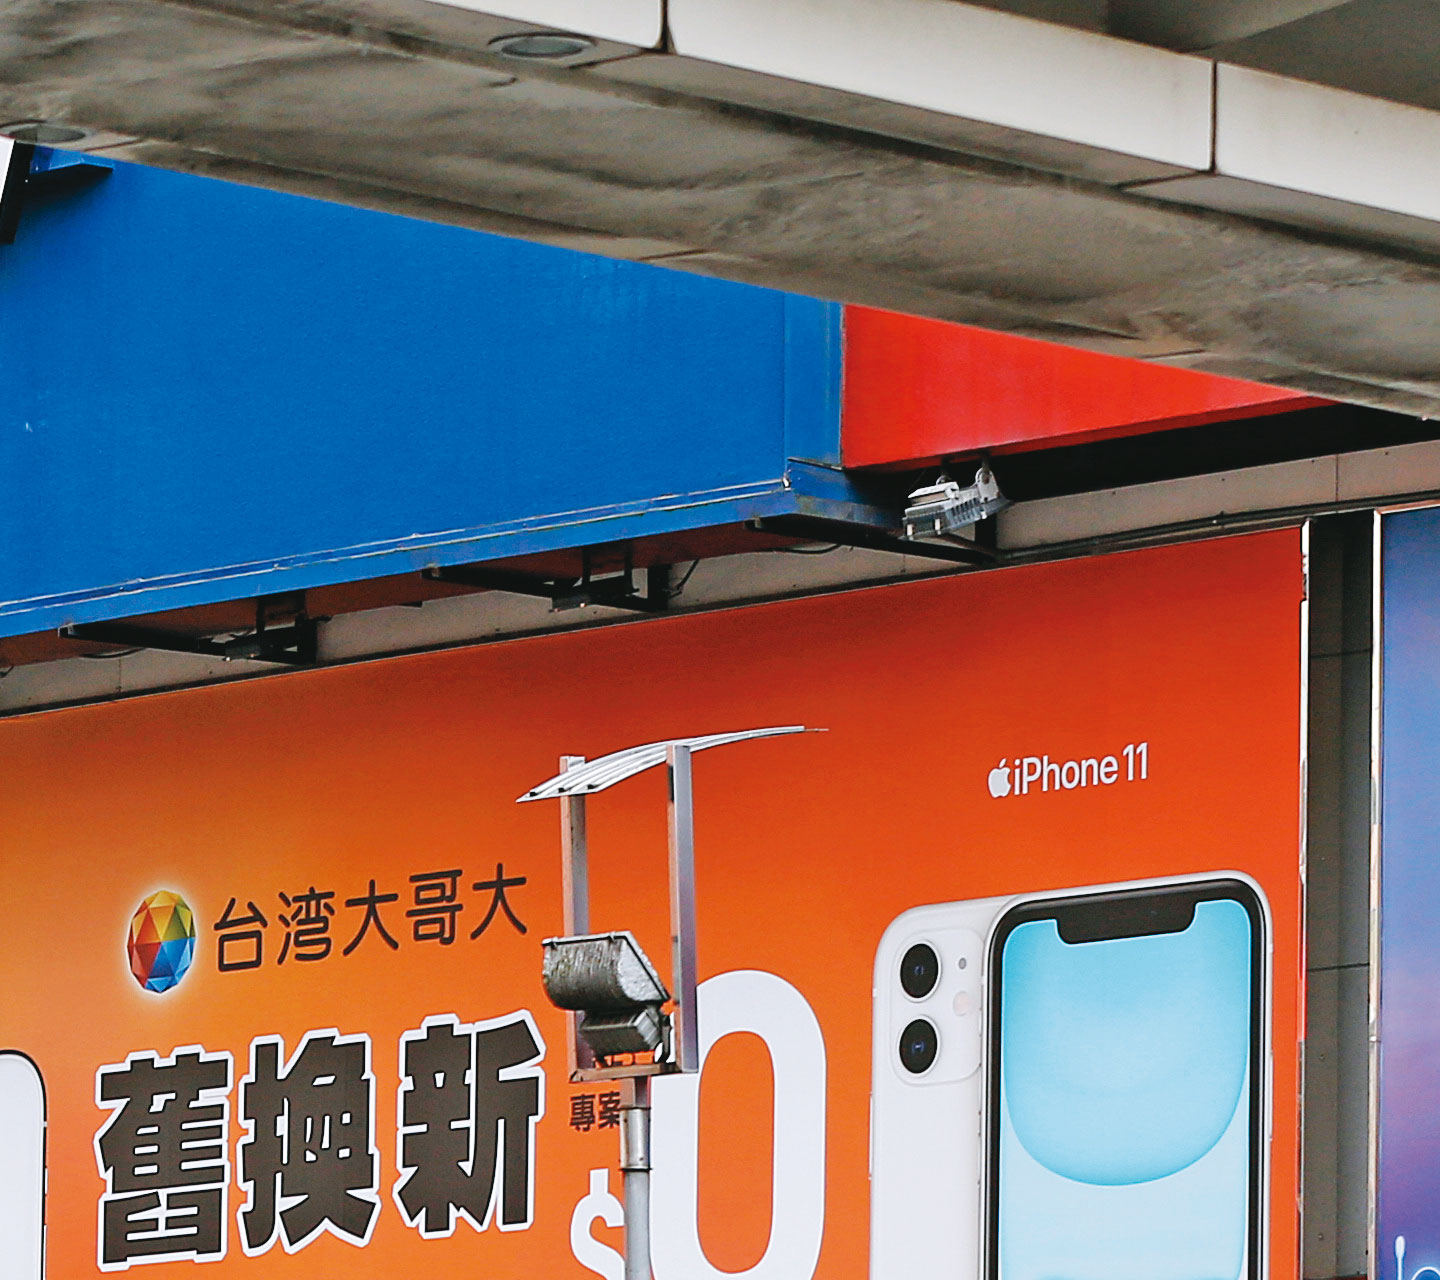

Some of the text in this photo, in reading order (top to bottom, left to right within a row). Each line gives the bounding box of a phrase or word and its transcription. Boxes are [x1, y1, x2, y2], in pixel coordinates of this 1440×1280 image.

[1013, 742, 1149, 796] iPhone 11
[94, 1008, 547, 1271] 舊換新
